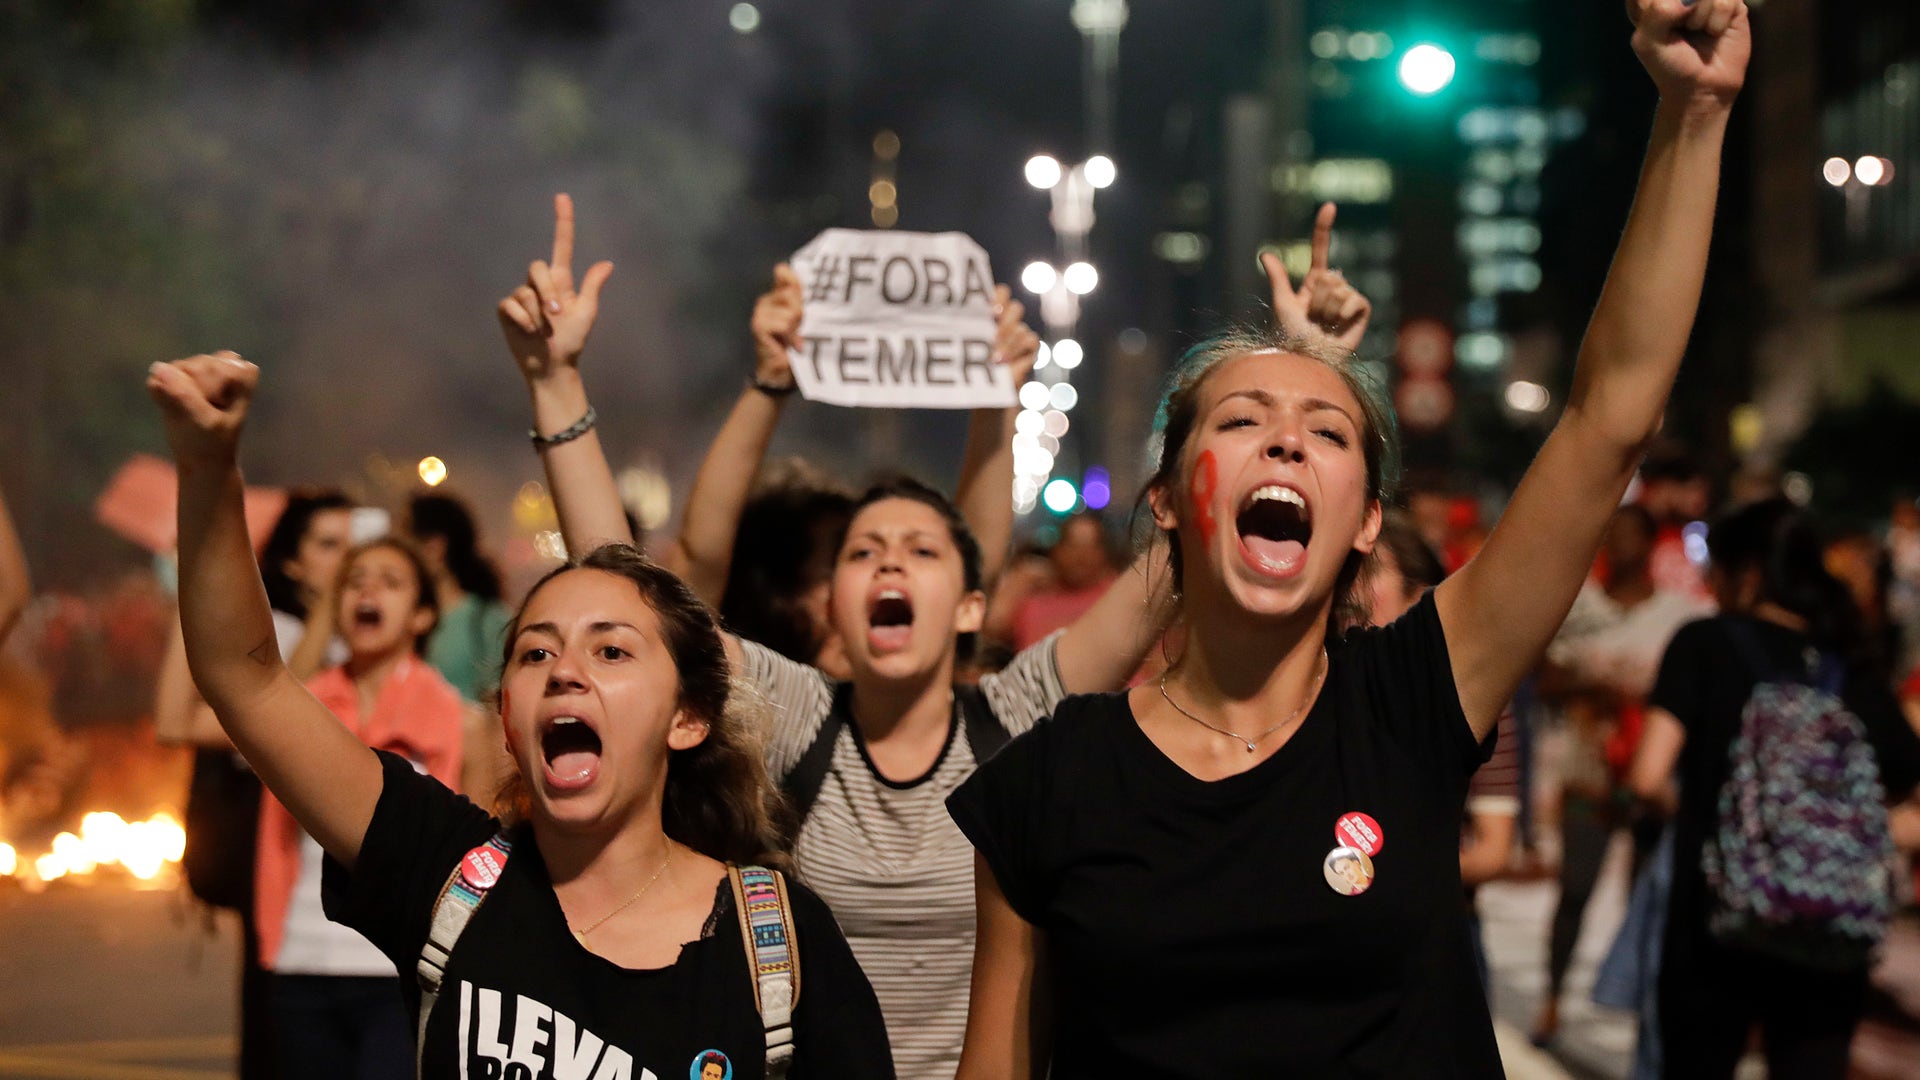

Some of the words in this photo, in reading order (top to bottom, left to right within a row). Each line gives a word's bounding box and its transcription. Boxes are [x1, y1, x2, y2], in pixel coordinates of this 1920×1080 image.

[808, 256, 990, 304] #FORA
[804, 336, 997, 384] TEMER
[467, 852, 495, 883] TEMER
[480, 851, 502, 877] FORA
[477, 987, 658, 1080] LEVA
